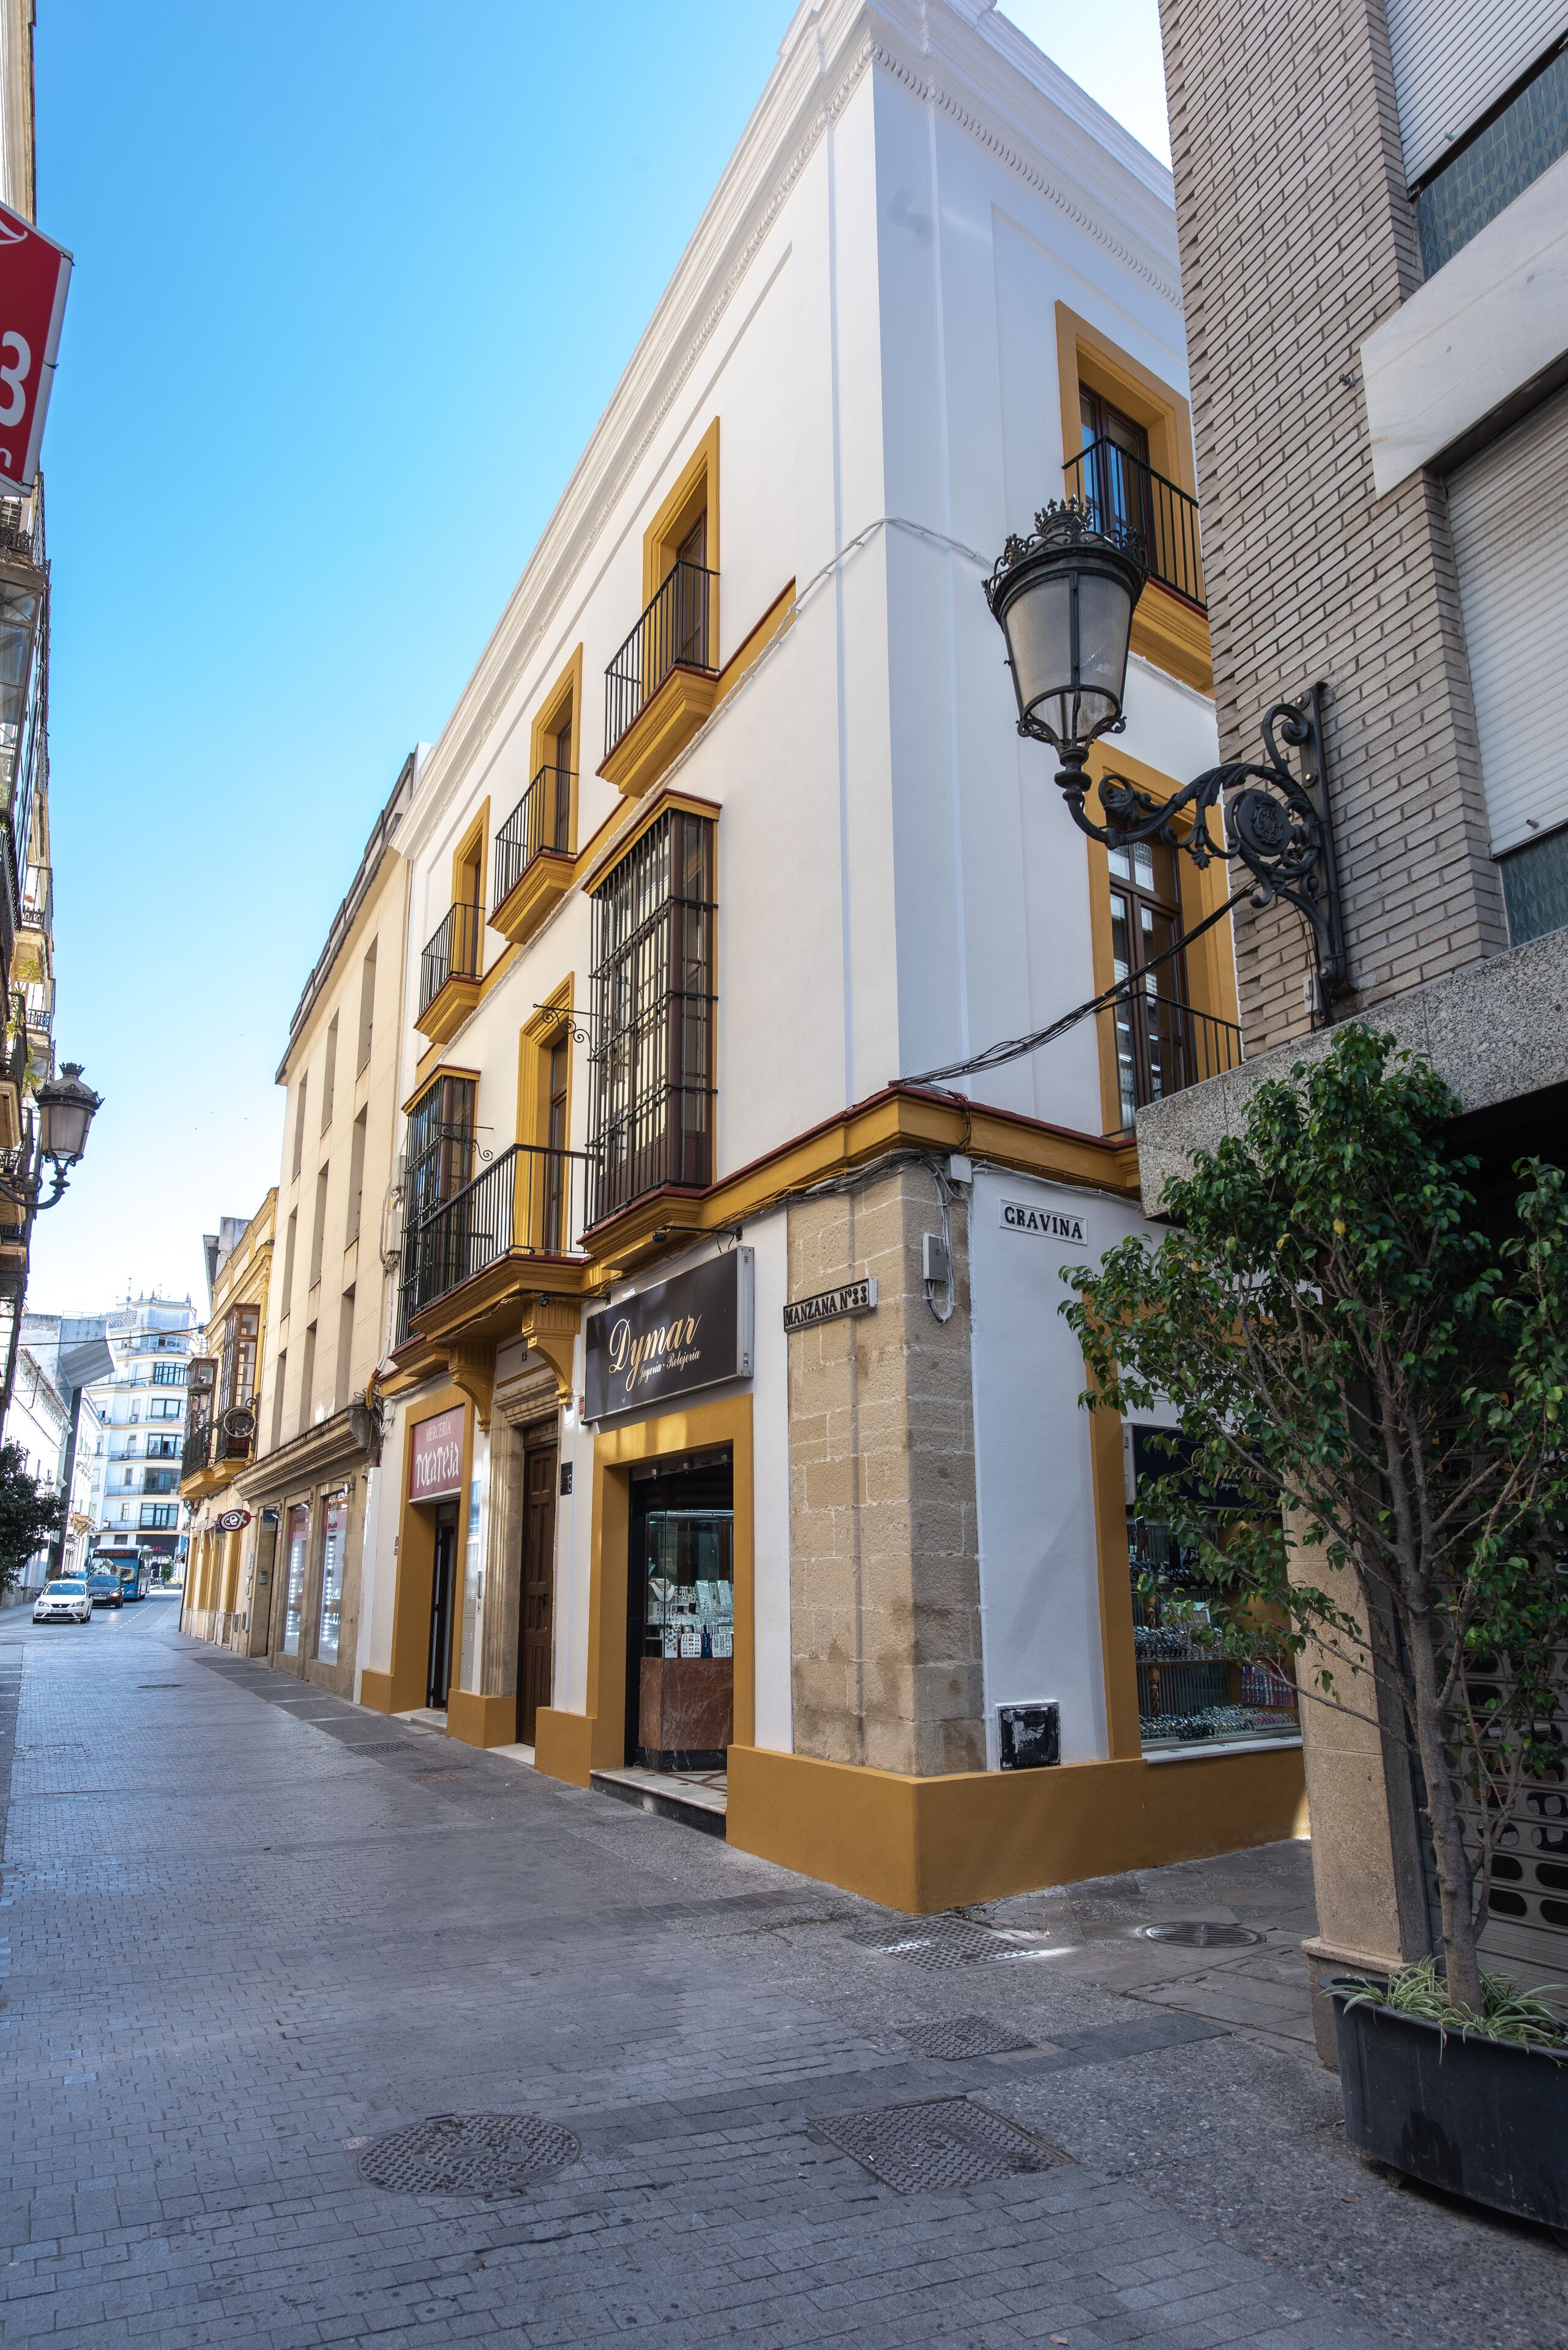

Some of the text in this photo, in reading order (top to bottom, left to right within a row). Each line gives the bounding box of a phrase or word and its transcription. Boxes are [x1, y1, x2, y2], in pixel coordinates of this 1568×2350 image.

[1004, 1206, 1083, 1239] GRAVINA
[785, 1294, 838, 1327] MANZANA
[521, 1351, 528, 1362] 15
[608, 1314, 702, 1392] Dymar
[638, 1347, 701, 1385] Joyería Relojería
[425, 1416, 451, 1442] MERCERÍA
